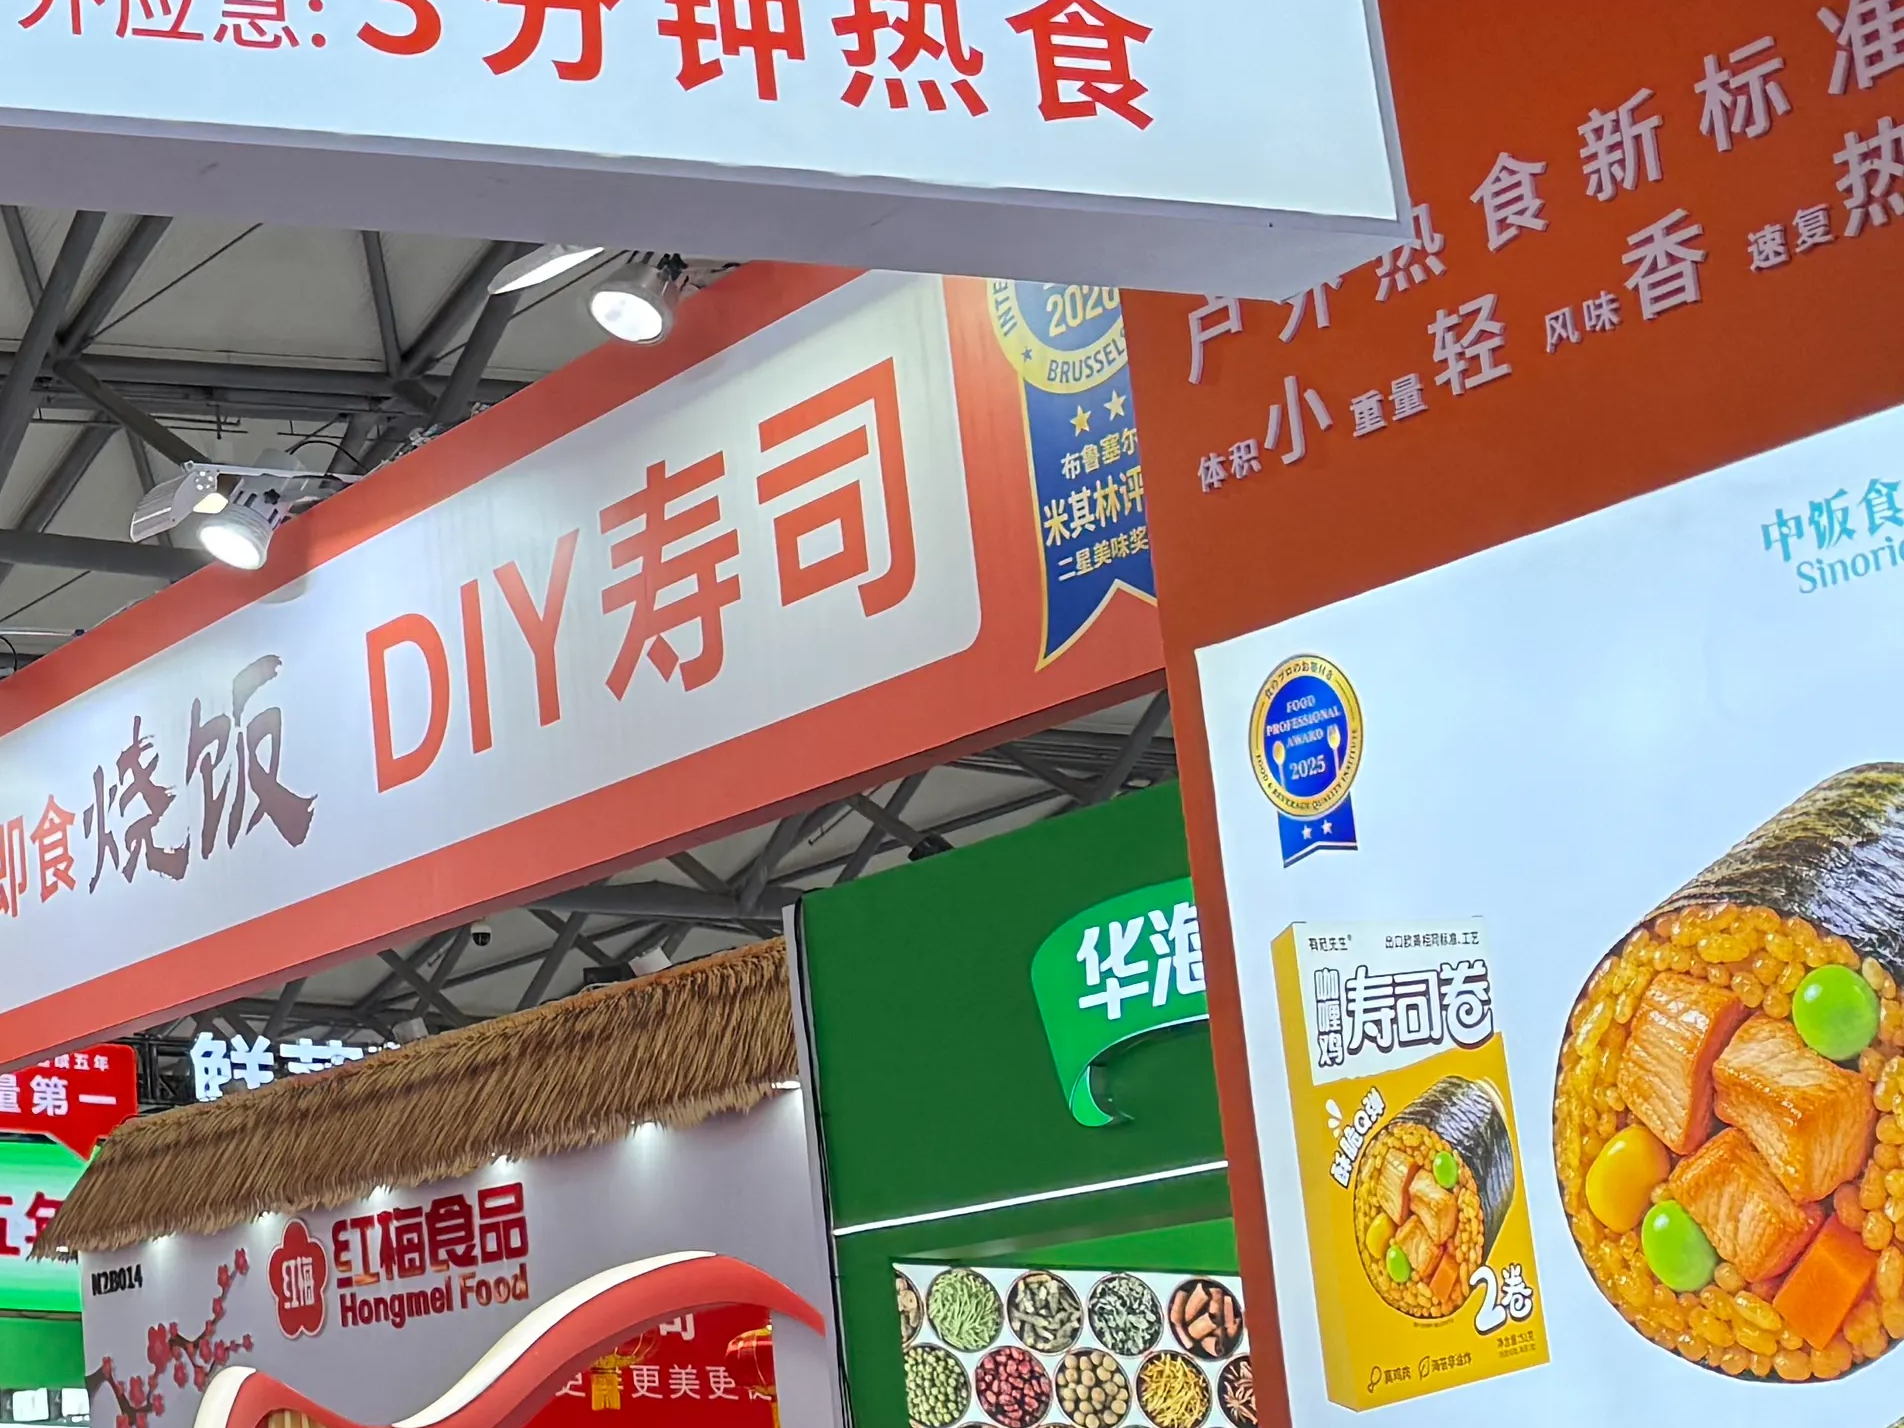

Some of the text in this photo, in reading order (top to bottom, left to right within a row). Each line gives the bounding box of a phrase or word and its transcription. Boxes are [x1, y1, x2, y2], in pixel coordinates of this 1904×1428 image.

[1061, 428, 1139, 480] 布鲁塞尔
[366, 356, 917, 793] DIY寿司
[1058, 526, 1149, 581] 二星美味奖
[1266, 705, 1342, 737] PROFESSIONAL
[1286, 694, 1316, 713] FOOD
[1286, 728, 1324, 748] AWARD
[1289, 755, 1326, 780] 2025
[1346, 960, 1495, 1054] 寿司卷
[332, 1181, 529, 1290] 红梅食品
[340, 1265, 529, 1329] Hongmei Food
